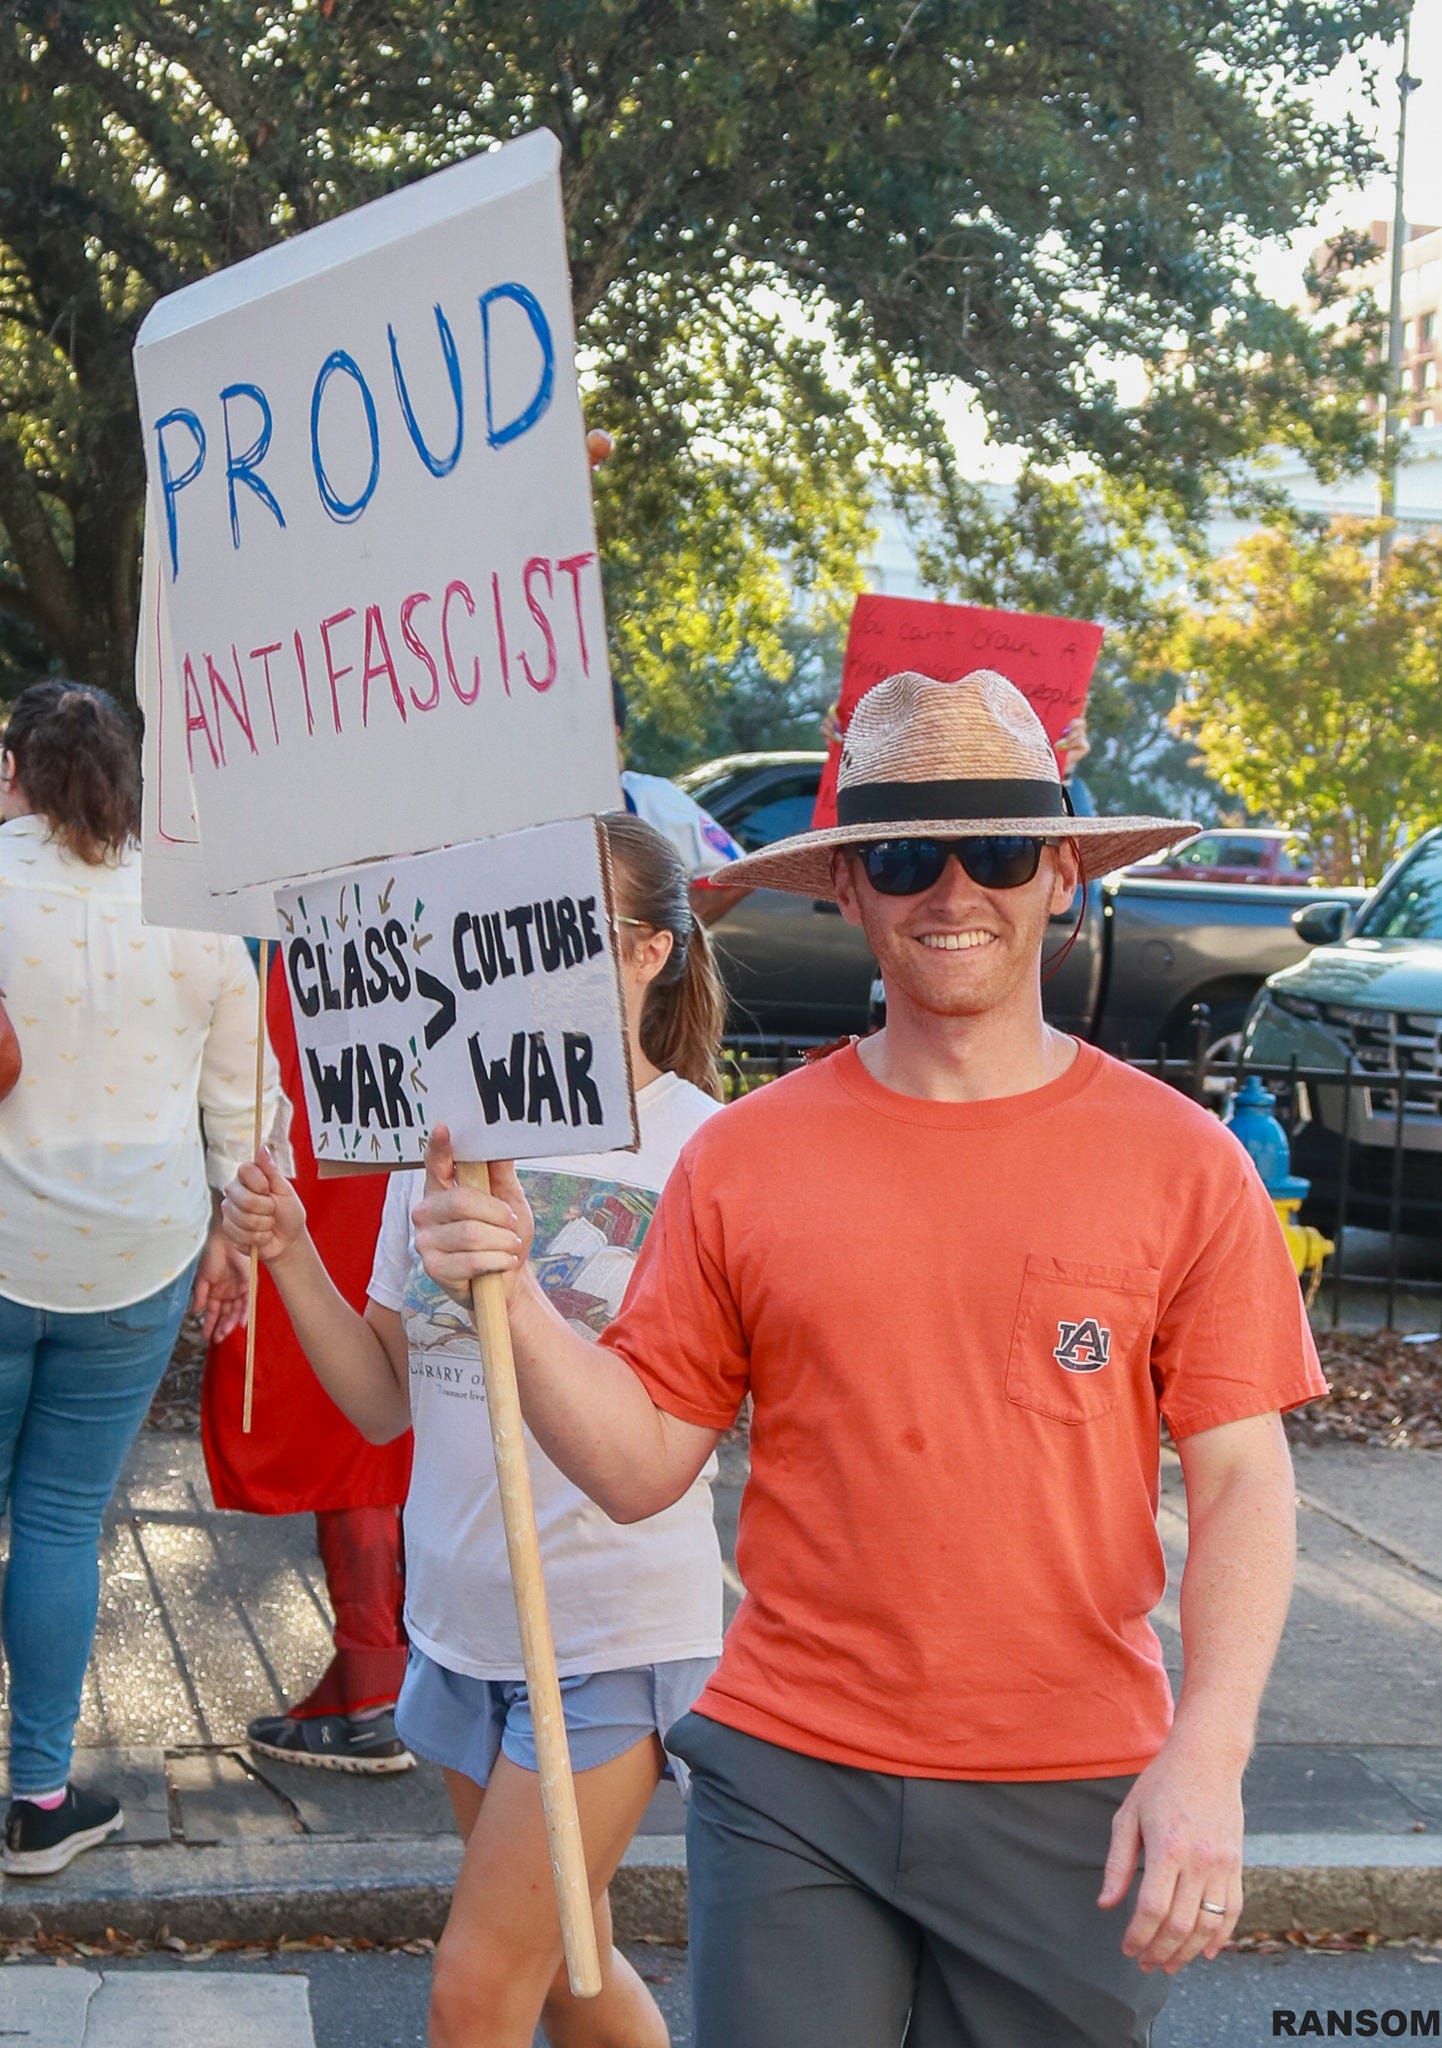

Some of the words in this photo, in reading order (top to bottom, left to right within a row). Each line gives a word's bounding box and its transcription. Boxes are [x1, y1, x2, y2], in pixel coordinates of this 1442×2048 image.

[153, 282, 555, 583] PROUD
[182, 552, 597, 775] ANTIFASCIST
[288, 918, 413, 1017] CLASS
[452, 895, 606, 991] CULTURE
[304, 1042, 414, 1129] WAR
[467, 1030, 604, 1127] WAR
